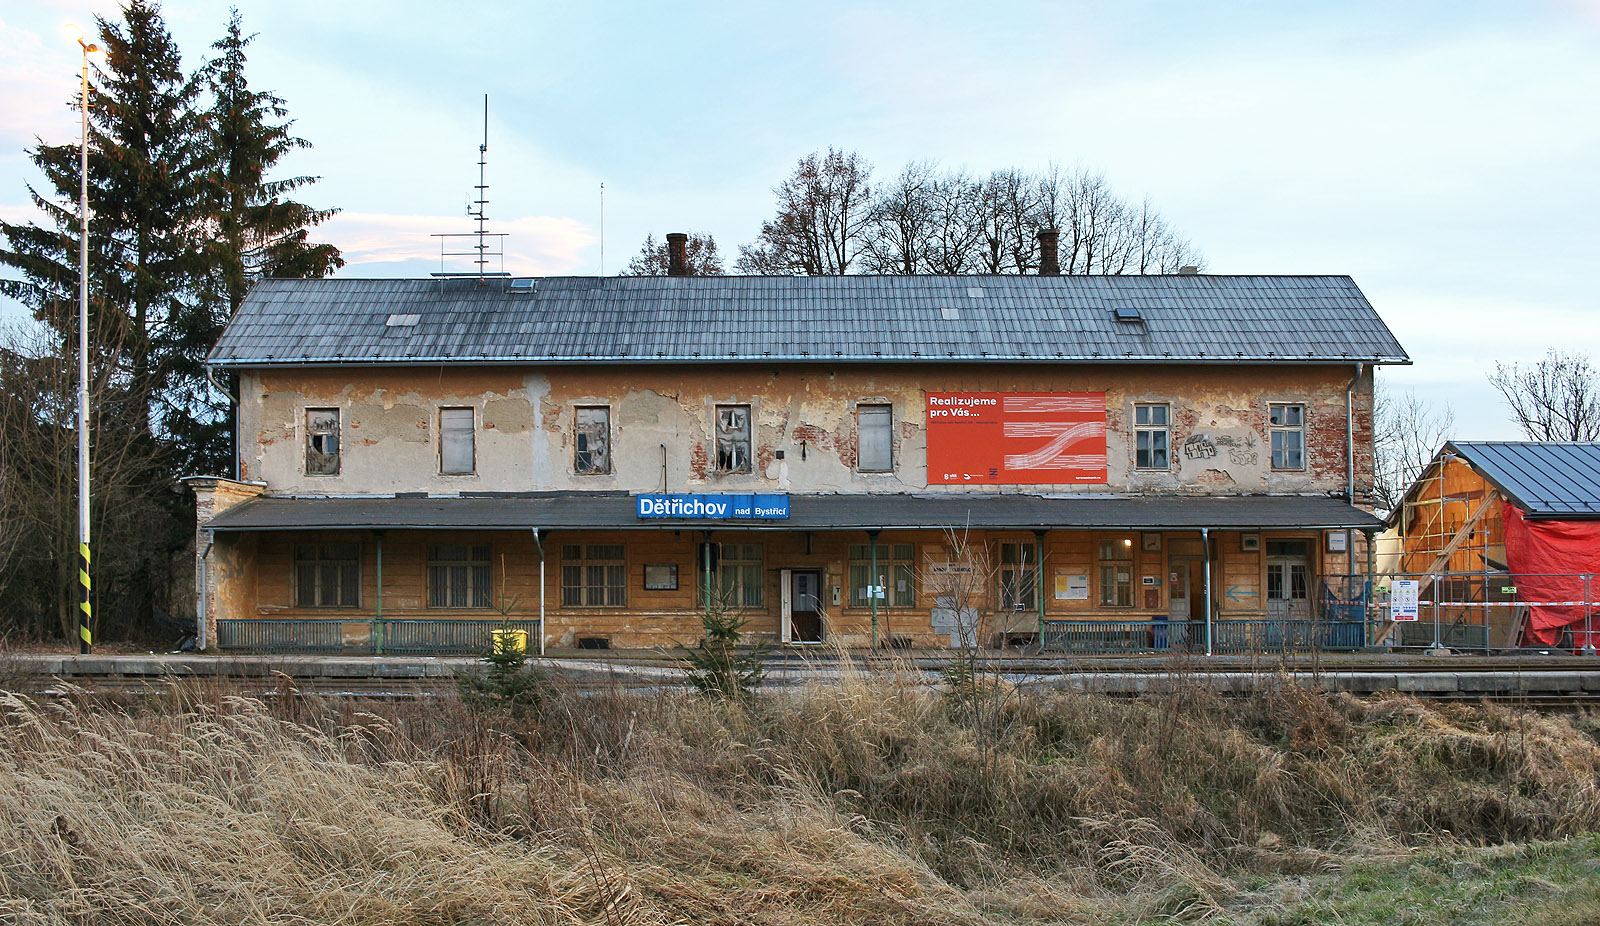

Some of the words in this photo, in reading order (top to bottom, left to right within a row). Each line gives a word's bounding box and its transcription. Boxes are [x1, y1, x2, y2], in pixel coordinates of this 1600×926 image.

[930, 396, 997, 407] Realizujeme
[930, 409, 949, 419] pro
[640, 498, 727, 515] Dětřichov
[735, 507, 751, 516] nad
[755, 507, 786, 517] Bystřicí
